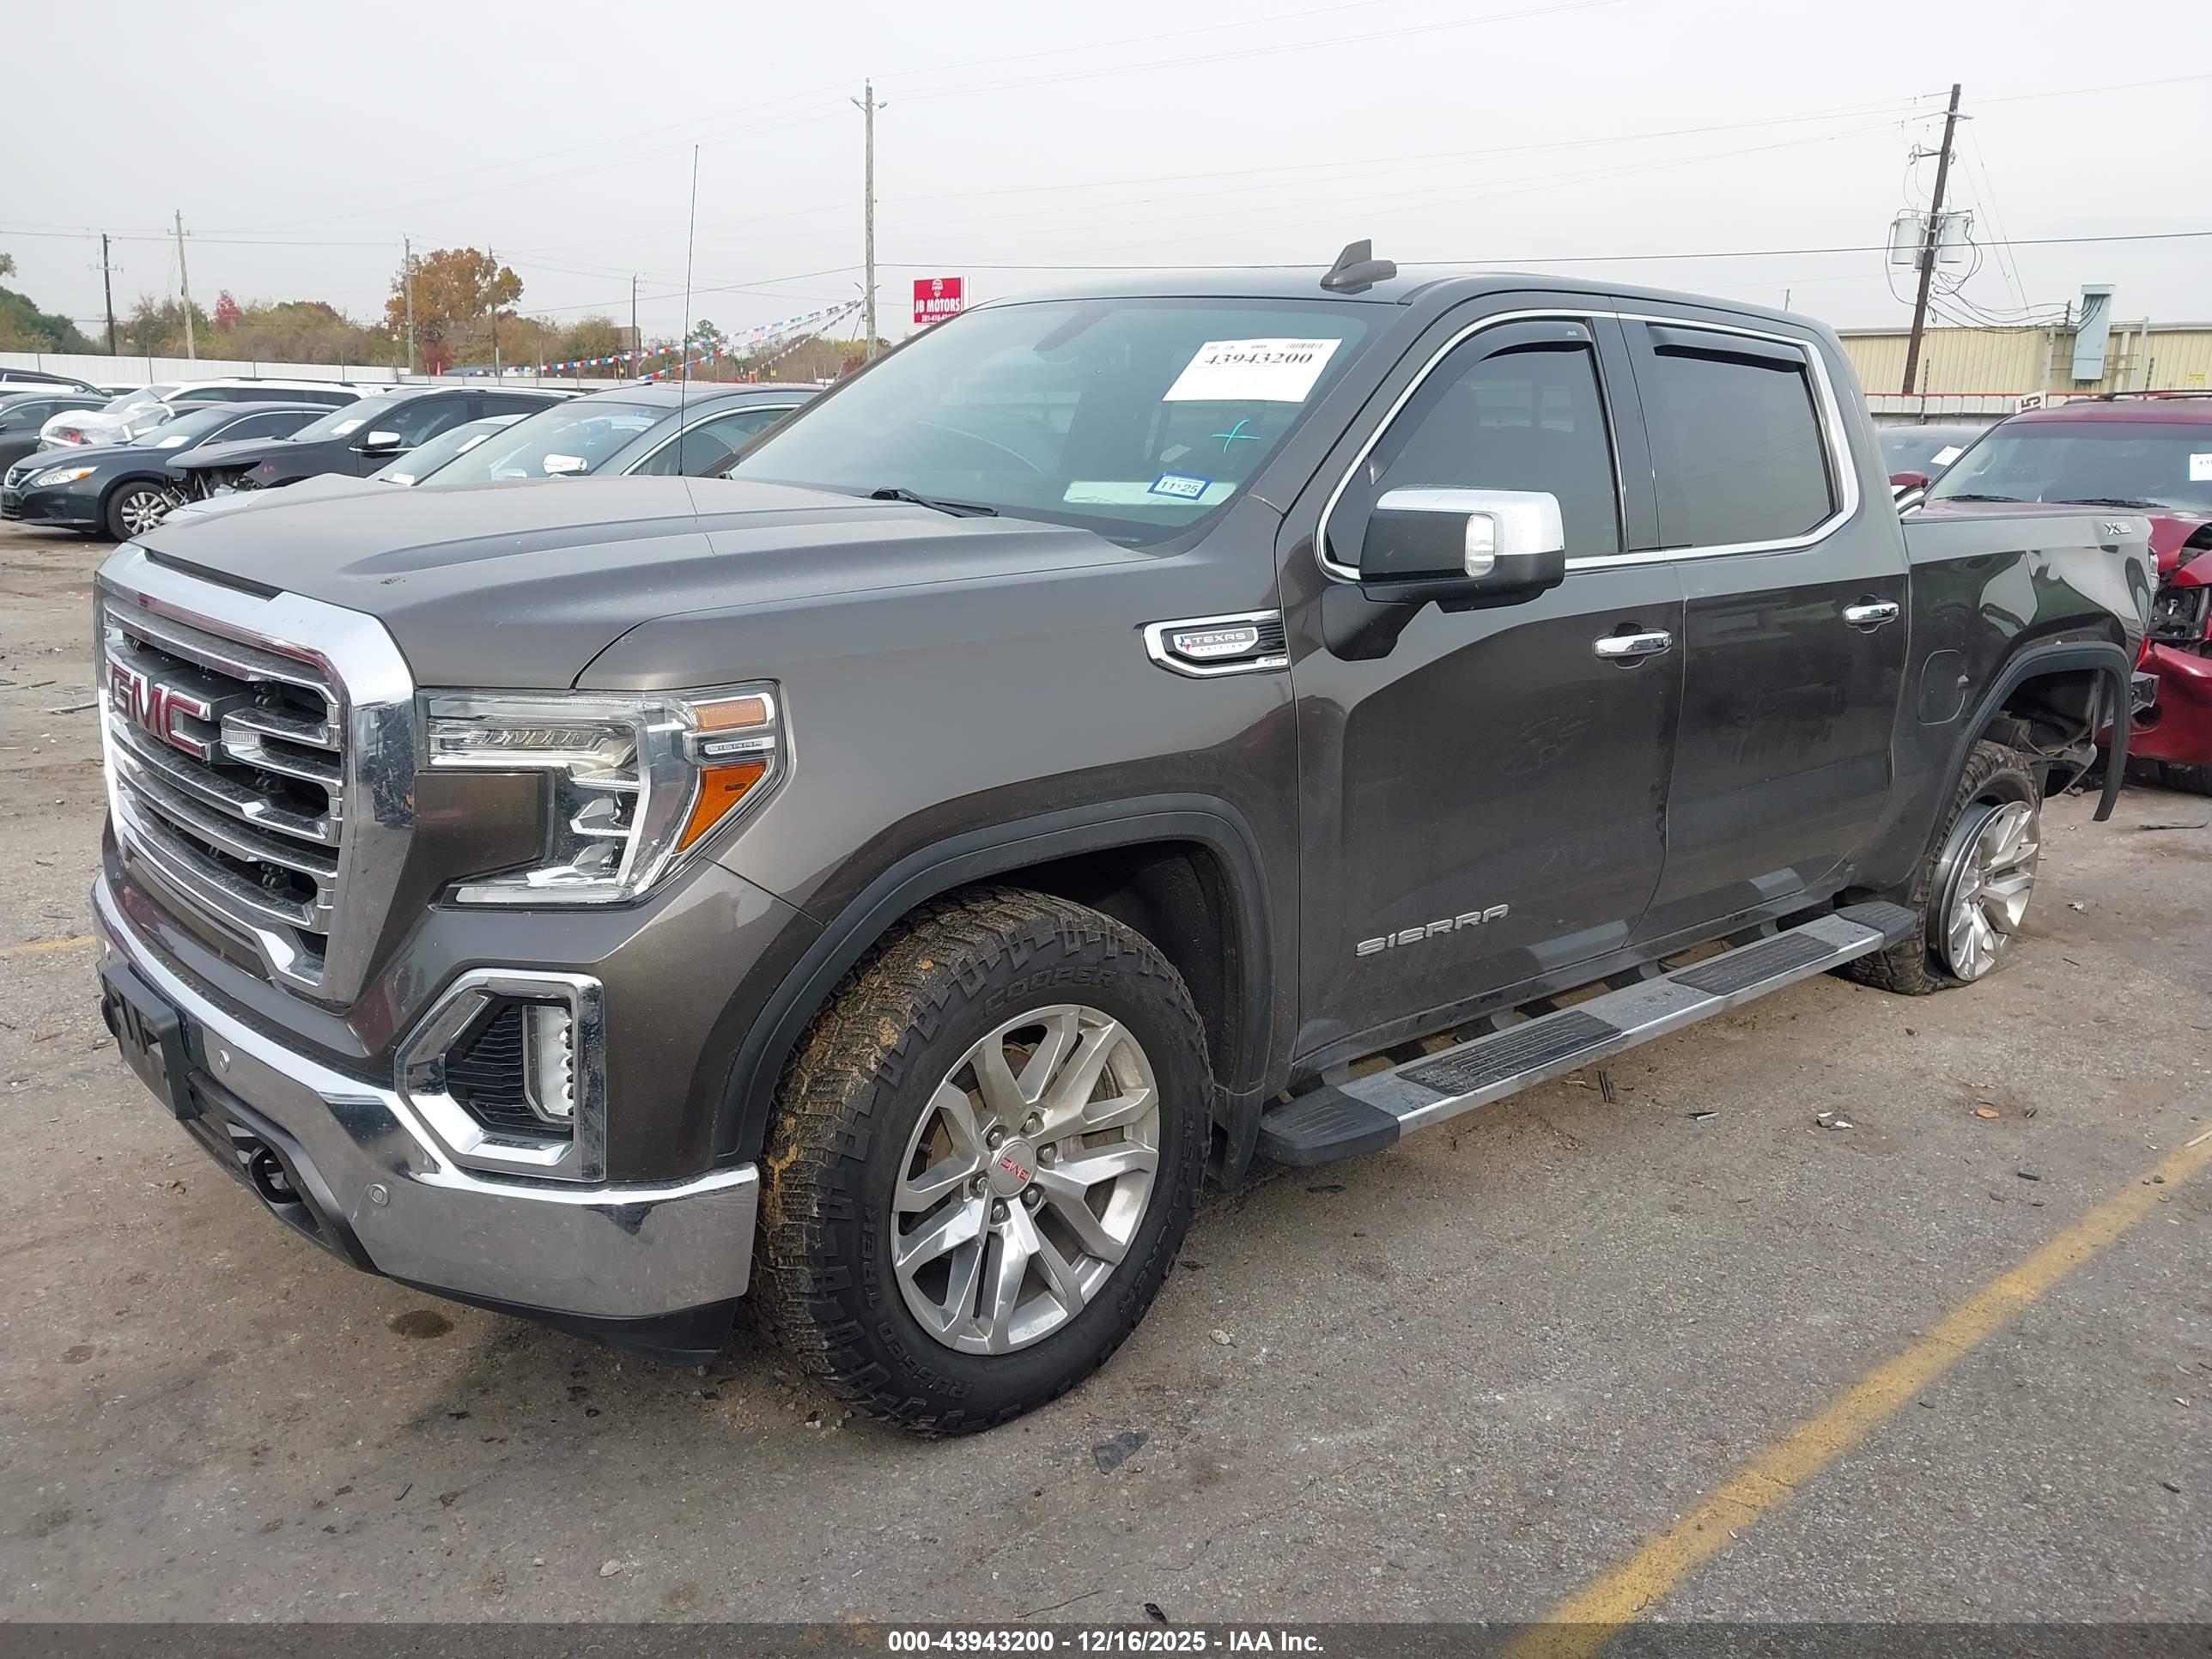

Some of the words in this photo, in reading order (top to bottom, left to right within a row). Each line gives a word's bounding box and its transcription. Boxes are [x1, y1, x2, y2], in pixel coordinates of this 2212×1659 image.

[915, 300, 925, 313] JB
[927, 297, 960, 313] MOTORS
[1205, 352, 1313, 365] 43943200
[1161, 481, 1176, 490] 11
[1181, 483, 1200, 494] 25
[1193, 632, 1246, 644] TEXAS
[110, 664, 212, 763] GMC
[1355, 903, 1509, 957] SIERRA
[982, 965, 1120, 1018] COOPER
[1000, 1156, 1030, 1182] GMC
